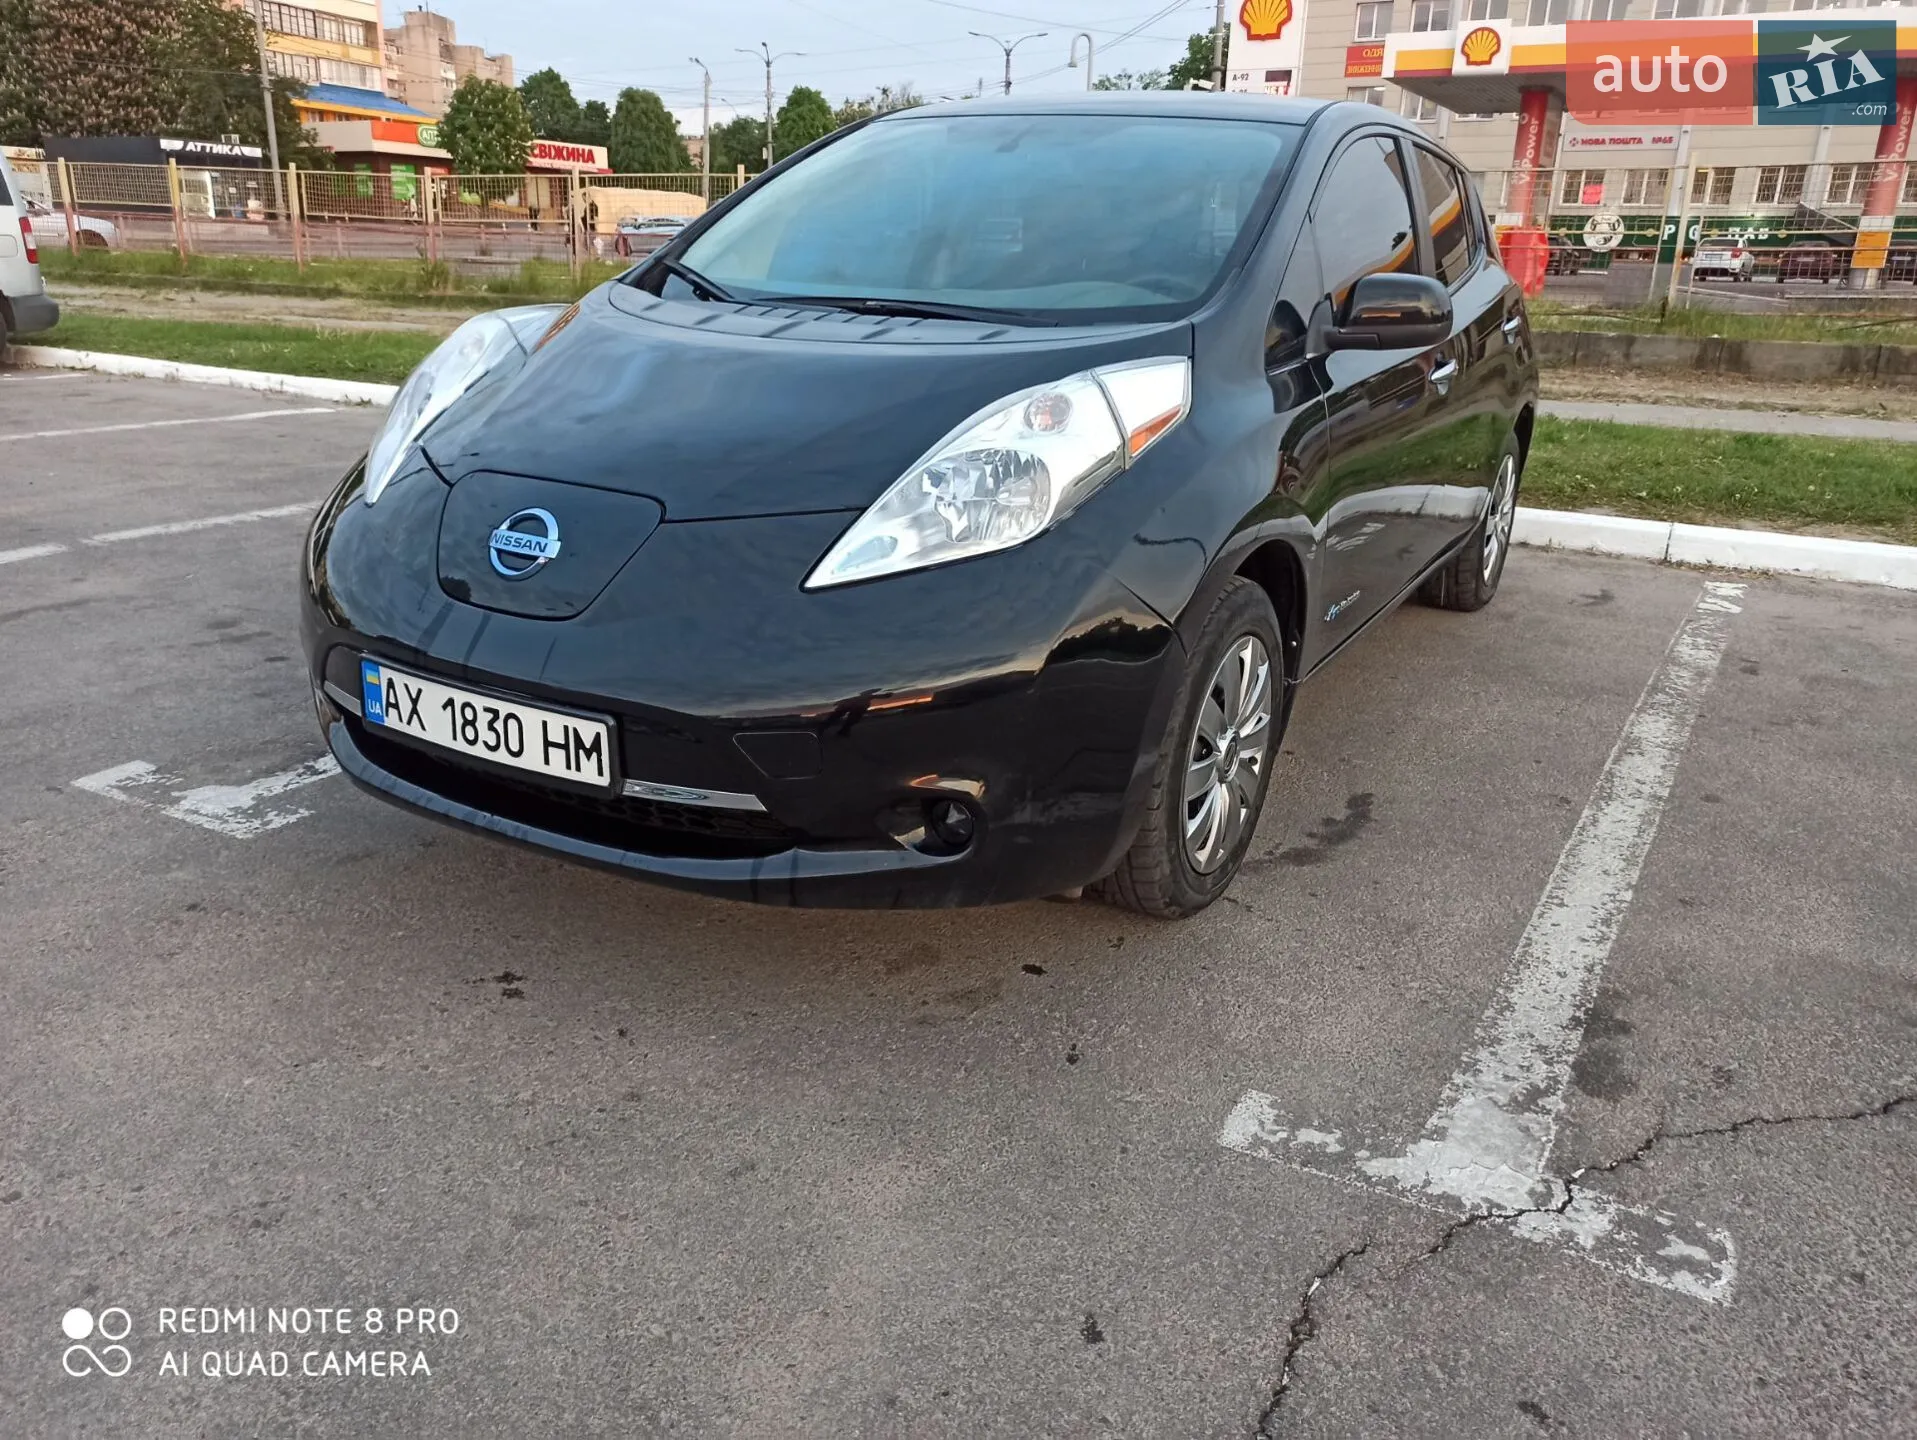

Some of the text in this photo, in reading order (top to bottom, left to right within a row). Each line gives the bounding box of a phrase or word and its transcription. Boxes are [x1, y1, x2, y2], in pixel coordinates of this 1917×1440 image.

[185, 141, 242, 156] АТТИКА
[1608, 137, 1644, 145] ПОШТА
[1518, 117, 1539, 185] V-Power
[491, 532, 549, 553] NISSAN
[368, 699, 382, 715] UA
[385, 677, 604, 777] AX 1830 HM
